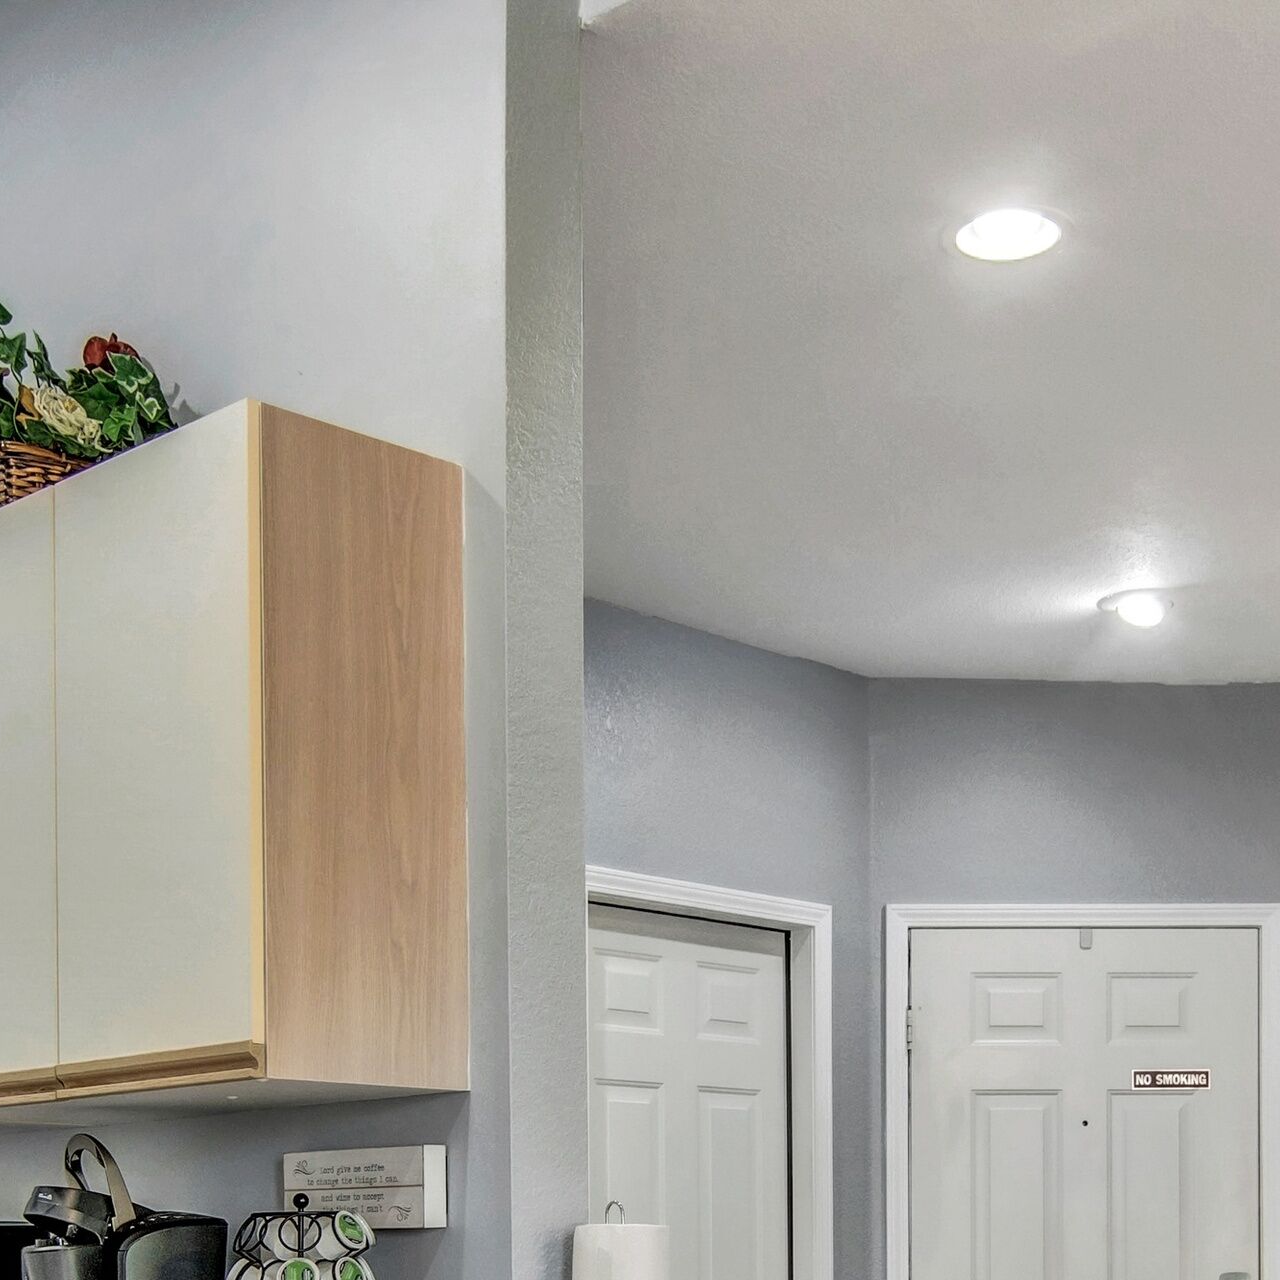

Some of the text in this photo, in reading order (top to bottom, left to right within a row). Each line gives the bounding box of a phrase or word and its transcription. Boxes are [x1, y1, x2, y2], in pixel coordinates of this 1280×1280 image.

[1135, 1073, 1208, 1086] NO SMOKING
[336, 1164, 351, 1176] give
[363, 1163, 385, 1172] coffee
[307, 1178, 315, 1186] to
[316, 1177, 339, 1187] change
[341, 1177, 353, 1185] the
[354, 1175, 378, 1186] things
[320, 1192, 385, 1203] and wine to accept
